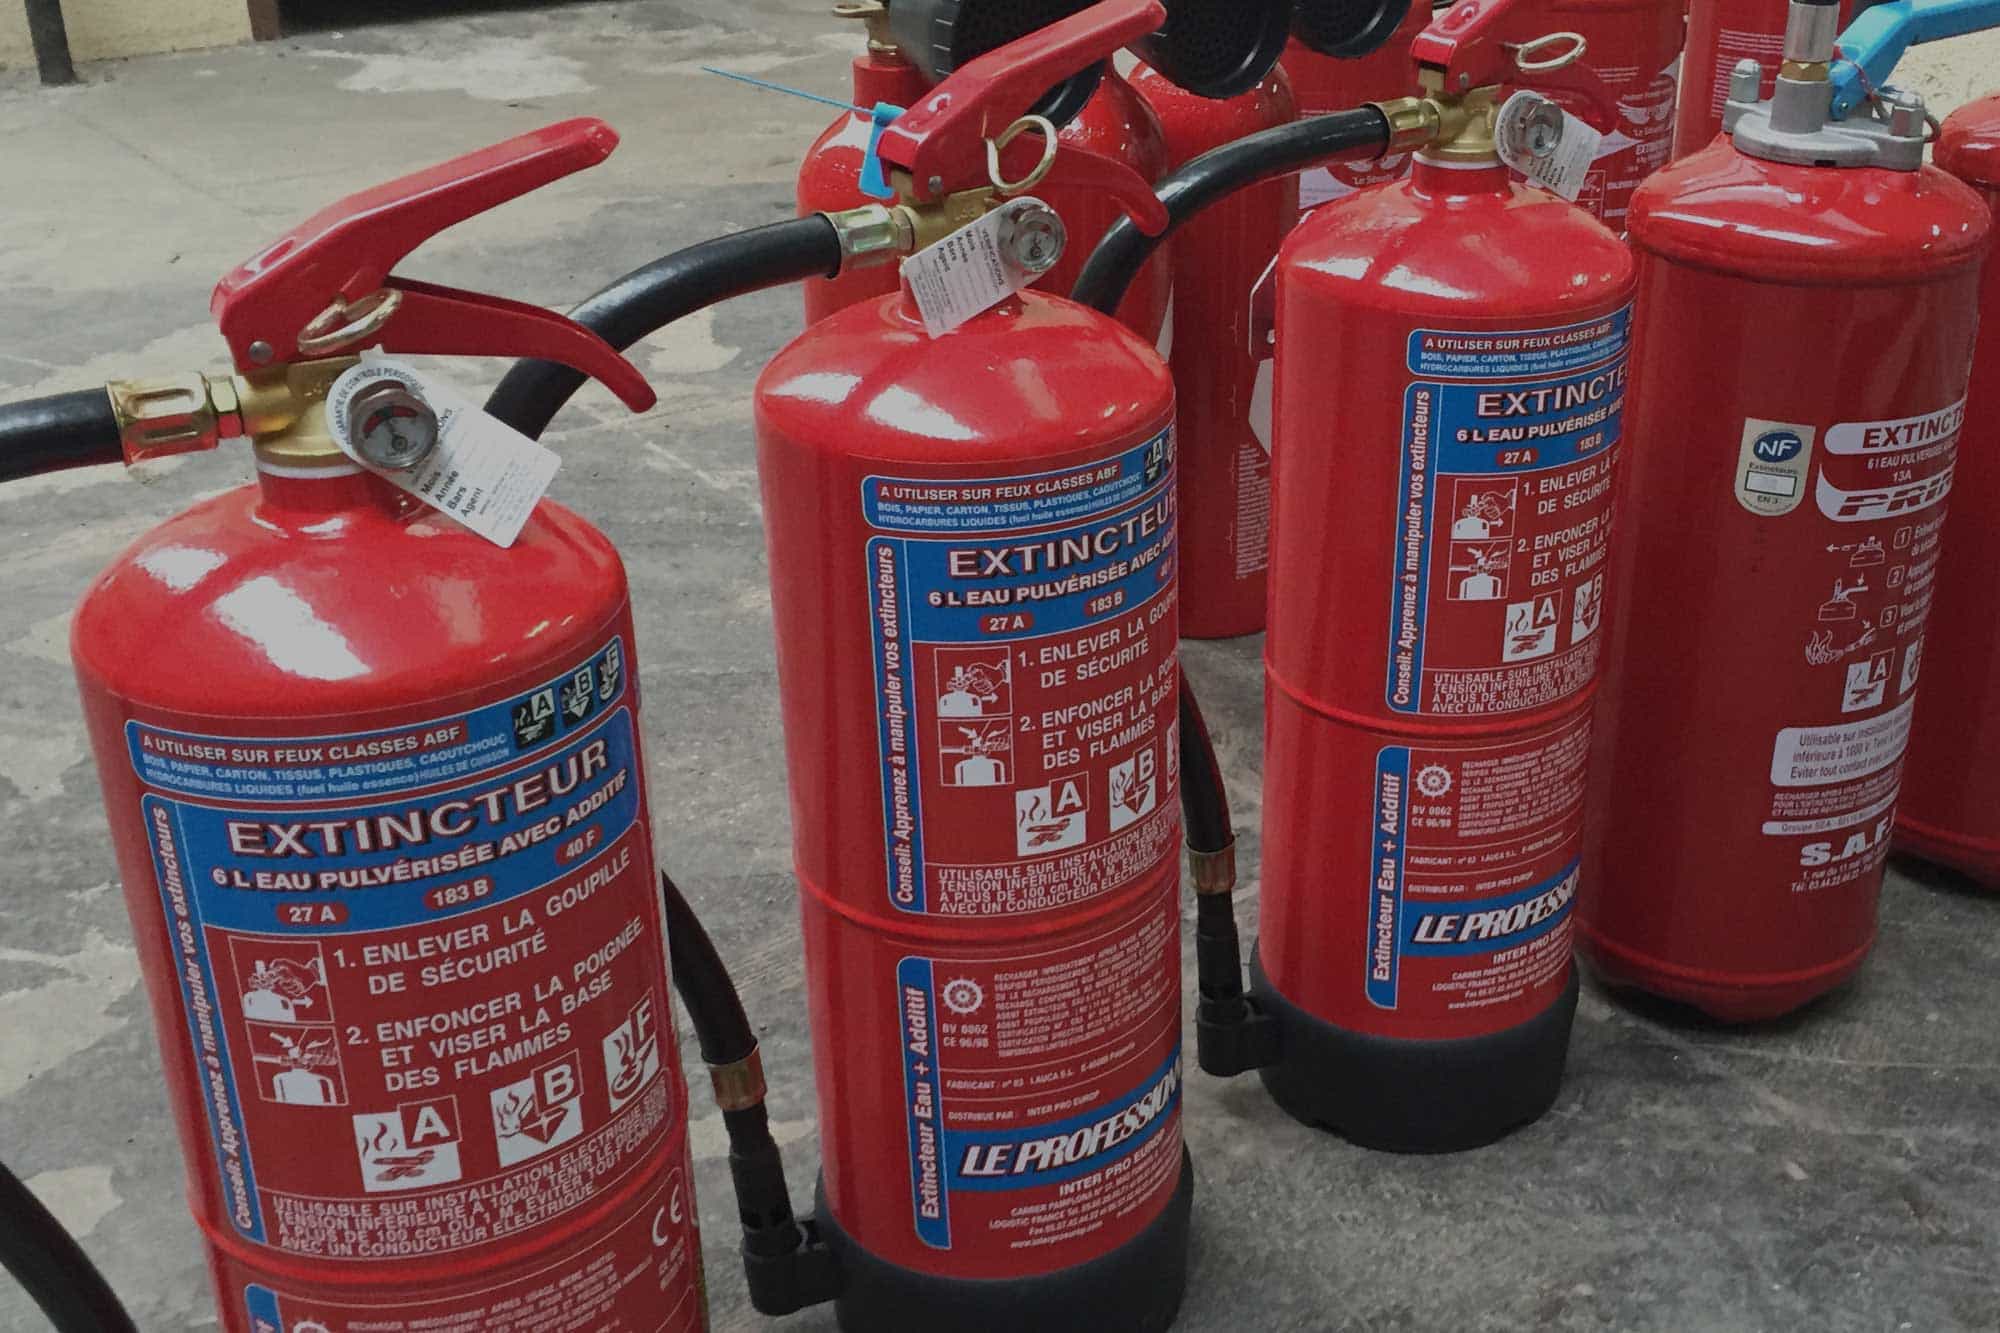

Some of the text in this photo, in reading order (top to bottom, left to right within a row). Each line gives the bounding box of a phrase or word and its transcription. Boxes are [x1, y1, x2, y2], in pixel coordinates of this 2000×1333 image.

[1437, 327, 1596, 350] UTILISER SUR FEUX CLASSES
[1456, 430, 1467, 442] 6
[1489, 427, 1524, 442] EAU
[1758, 439, 1799, 457] NF
[1504, 452, 1520, 464] 27
[420, 471, 442, 495] Mois
[434, 469, 460, 503] Année
[880, 464, 1119, 501] A UTILISER SUR FEUX CLASSES ABF
[1539, 465, 1597, 494] ENLEVER
[446, 486, 467, 510] Bars
[460, 487, 483, 518] Agent
[945, 504, 990, 516] CARTON,
[1538, 499, 1557, 515] DE
[1393, 391, 1430, 704] Conseil: Apprenez manipuler vos extincteurs
[1534, 516, 1599, 551] ENFONCER
[1533, 552, 1552, 568] ET
[1558, 538, 1592, 561] VISER
[928, 543, 1161, 606] 6 L EAU PULVÉRISÉE AVEC
[1531, 570, 1560, 587] DES
[877, 546, 895, 640] extincteurs
[1090, 596, 1113, 614] 183
[989, 616, 1025, 632] 27 A
[1536, 597, 1556, 625] A
[883, 640, 899, 662] vos
[1039, 617, 1145, 664] ENLEVER LA
[1040, 633, 1150, 689] DE SÉCURITÉ
[1873, 657, 1887, 681] A
[576, 671, 592, 692] B
[884, 662, 903, 753] manipuler
[1042, 673, 1155, 729] ENFONCER LA
[1042, 701, 1147, 749] ET VISER LA
[1043, 713, 1156, 770] DES FLAMMES
[143, 726, 460, 763] A UTILISER SUR FEUX CLASSES ABF
[170, 733, 507, 781] PAPIER, CARTON, TISSUS, PLASTIQUES, CAOUTCHOUC
[1139, 748, 1155, 781] B
[227, 740, 608, 855] EXTINCTEUR
[234, 783, 293, 796] LIQUIDES
[893, 767, 914, 841] Apprenez
[1056, 780, 1083, 813] A
[212, 768, 628, 890] 6 L EAU PULVÉRISÉE AVEC ADDITIF
[566, 830, 597, 858] 40 F
[152, 806, 189, 917] extincteurs
[939, 862, 1055, 880] UTILISABLE SUR
[1373, 772, 1400, 981] Extincteur Eau Additif
[432, 879, 490, 907] 183 B
[939, 879, 1001, 892] TENSION
[940, 882, 1098, 914] AVEC UN CONDUCTEUR
[954, 882, 1069, 904] PLUS DE 100 cm
[288, 905, 337, 922] 27 A
[334, 847, 630, 969] 1. ENLEVER LA GOUPILLE
[178, 918, 195, 949] vos
[1414, 914, 1460, 943] LE
[345, 915, 644, 1045] 2. ENFONCER LA POIGNÉE
[368, 932, 548, 995] DE SÉCURITÉ
[380, 970, 614, 1068] ET VISER LA BASE
[385, 1022, 572, 1093] DES FLAMMES
[543, 1063, 575, 1105] B
[905, 986, 940, 1219] Extincteur Eau Additif
[411, 1105, 451, 1144] A
[961, 1143, 1013, 1177] LE
[1059, 1157, 1131, 1196] INTER PRO
